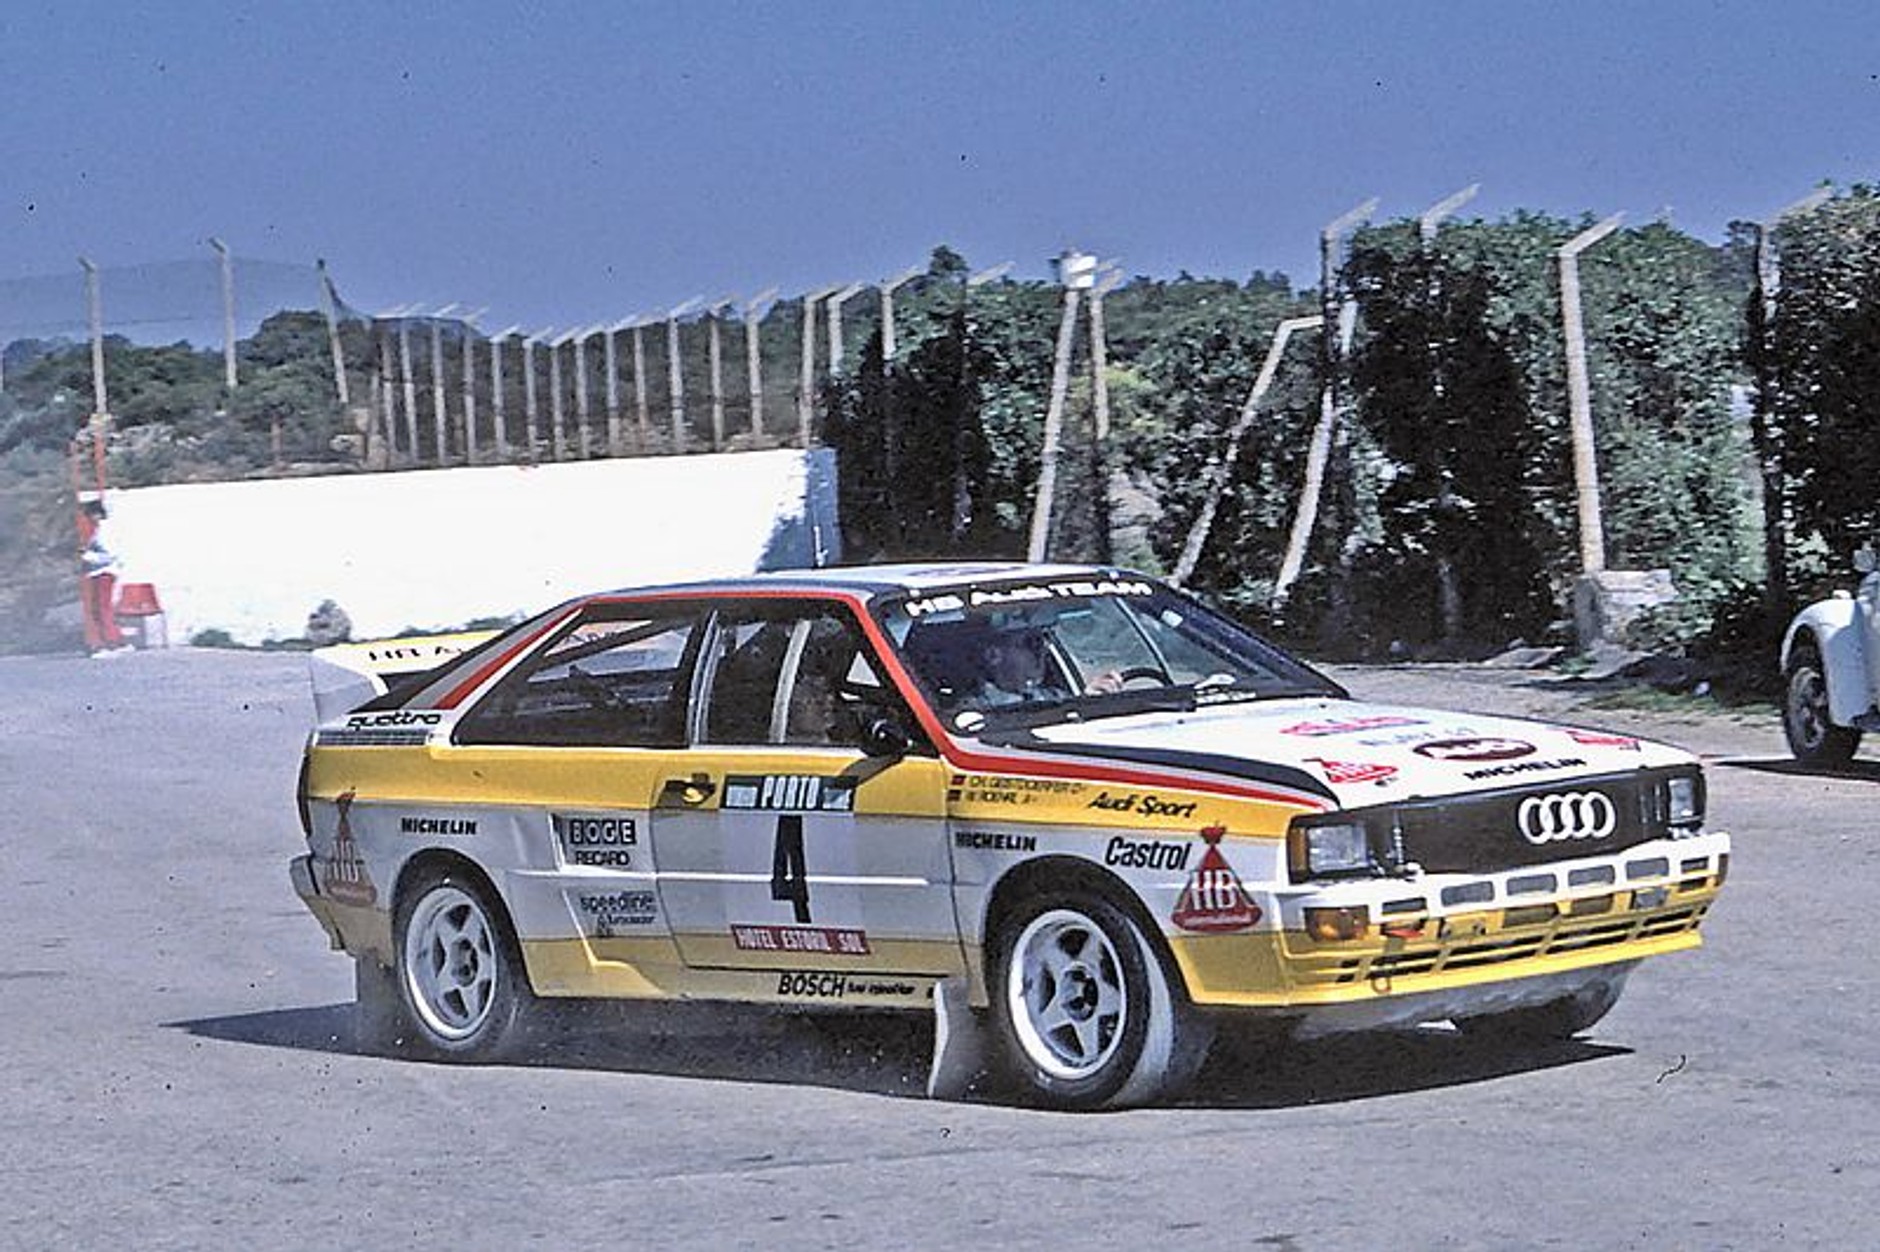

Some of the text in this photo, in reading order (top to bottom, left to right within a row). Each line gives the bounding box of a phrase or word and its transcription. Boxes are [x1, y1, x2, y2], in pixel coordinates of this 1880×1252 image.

[905, 595, 964, 617] HB
[1049, 582, 1152, 597] TEAM
[346, 711, 441, 731] quattro
[1463, 757, 1587, 781] MICHELIN
[761, 775, 820, 809] PORTO
[1088, 791, 1197, 818] Audi Sport
[401, 817, 477, 835] MICHELIN
[570, 820, 636, 844] BOGE
[955, 831, 1037, 851] MICHELIN
[1105, 836, 1192, 871] Castrol
[575, 850, 631, 866] RECARO
[770, 814, 812, 923] 4
[1190, 868, 1238, 910] HB
[736, 927, 777, 949] HOTEL
[838, 932, 867, 953] SOL
[778, 973, 847, 997] BOSCH
